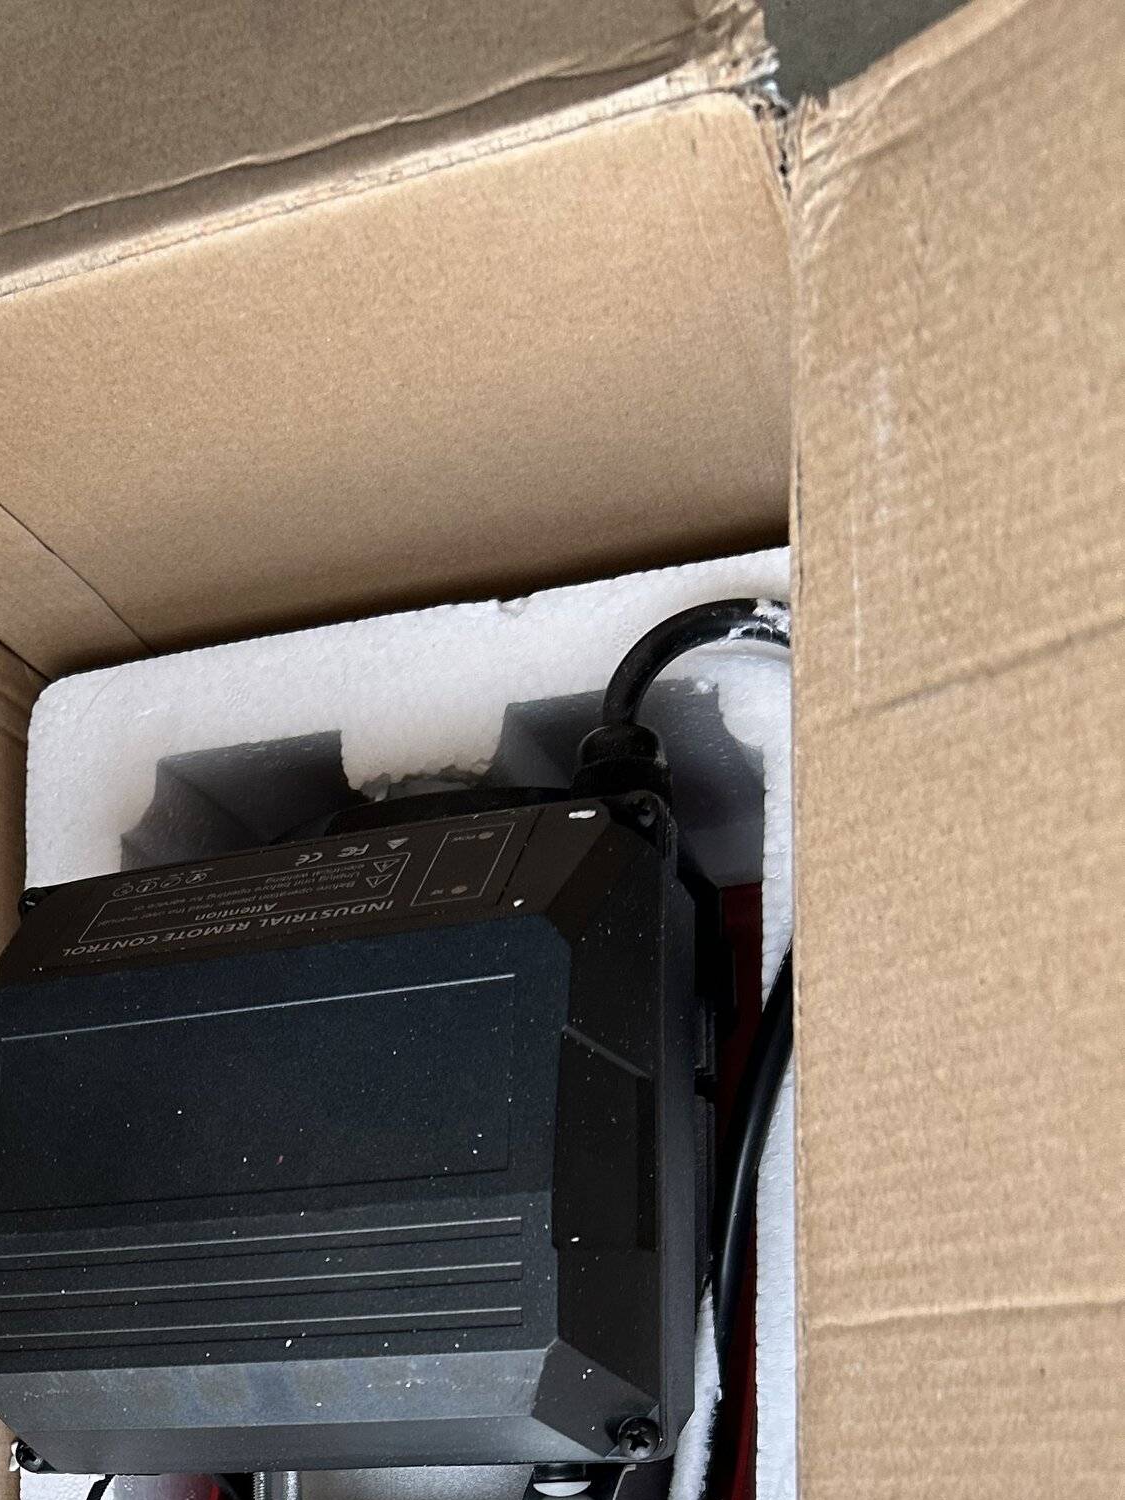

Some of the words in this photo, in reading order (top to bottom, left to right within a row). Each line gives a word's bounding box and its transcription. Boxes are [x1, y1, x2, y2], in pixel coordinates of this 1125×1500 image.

[194, 902, 277, 922] Attention
[258, 900, 394, 928] INDUSTRIAL
[161, 921, 251, 942] REMOTE
[61, 935, 159, 957] CONTROL
